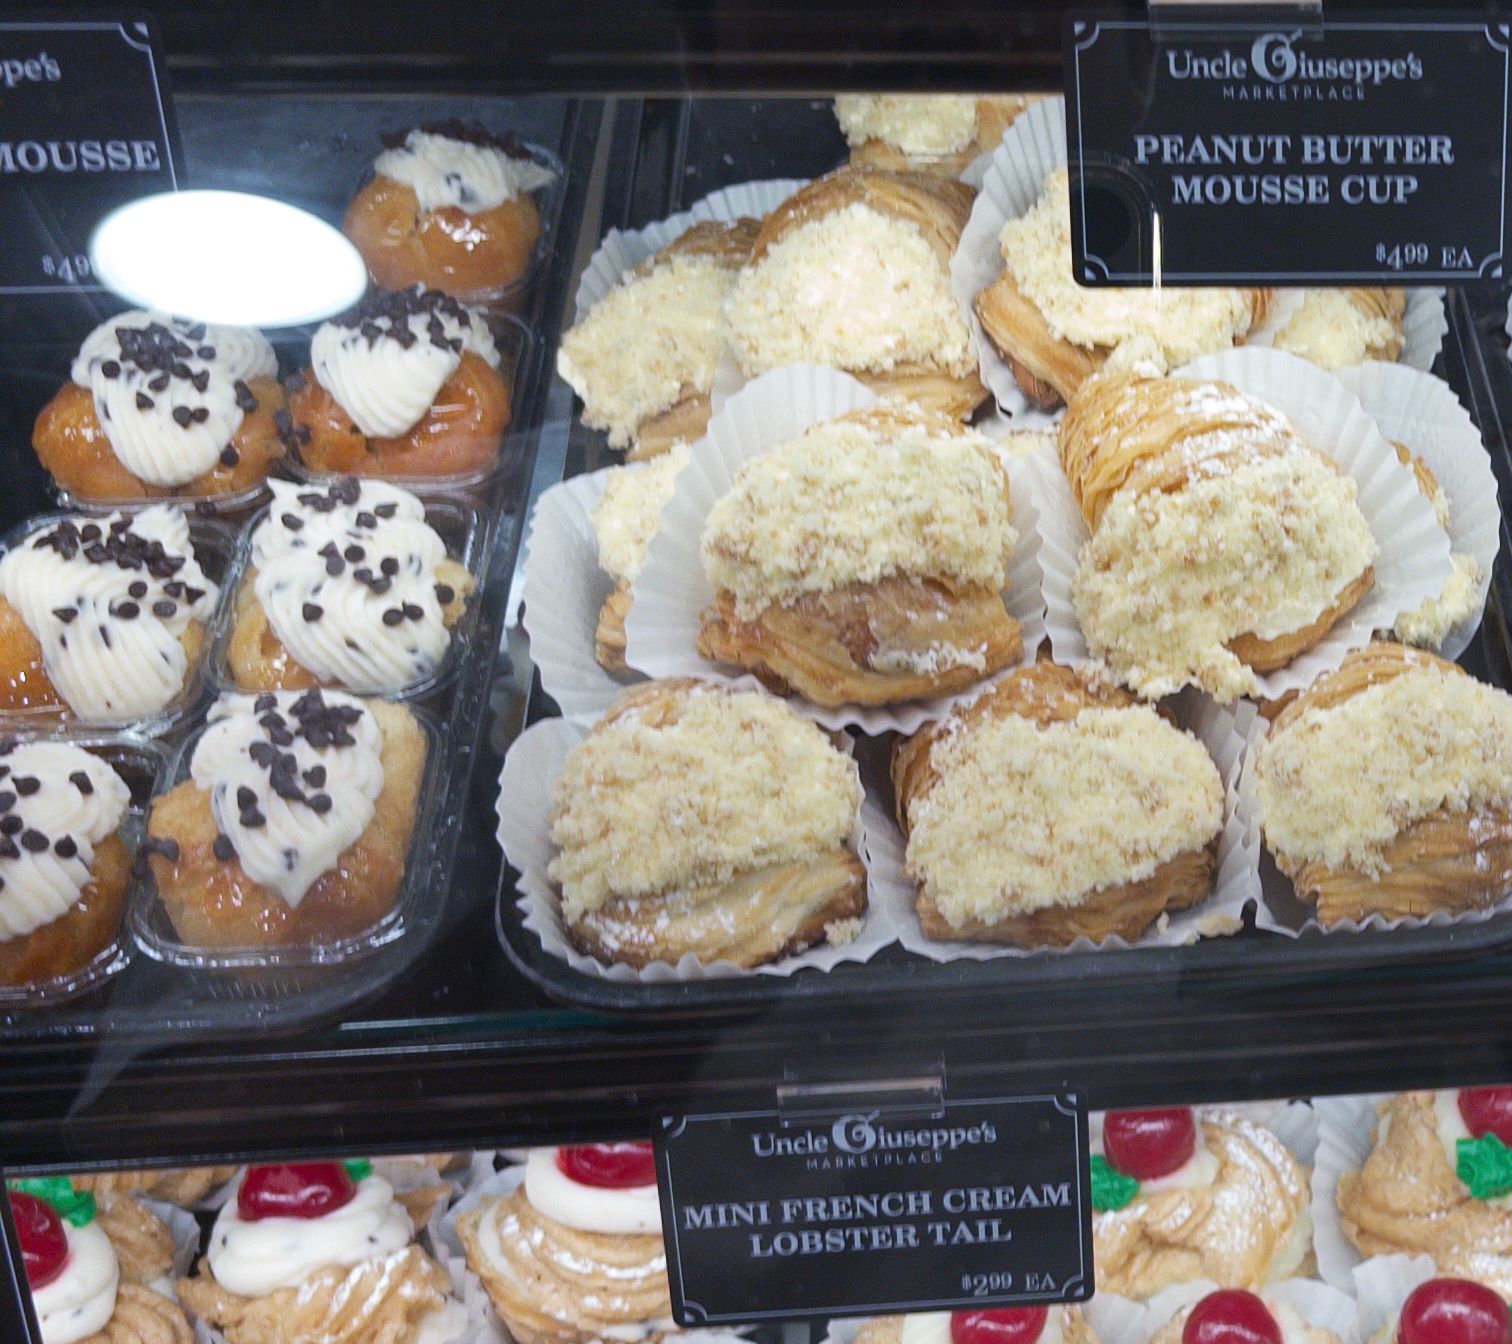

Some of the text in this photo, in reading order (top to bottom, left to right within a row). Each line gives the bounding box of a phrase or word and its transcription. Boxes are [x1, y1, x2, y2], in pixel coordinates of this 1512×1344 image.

[1166, 28, 1424, 85] Uncle Giuseppe's
[1223, 85, 1365, 102] MARKETPLACE
[1134, 134, 1455, 166] PEANUT BUTTER
[1171, 174, 1419, 205] MOUSSE CUP
[1441, 247, 1474, 268] EA
[751, 1110, 997, 1157] Uncle Giuseppe's
[806, 1151, 944, 1170] MARKETPLACE
[683, 1182, 1072, 1231] MINI FRENCH CREAM
[749, 1218, 1012, 1257] LOBSTER TAIL
[1025, 1271, 1057, 1291] EA
